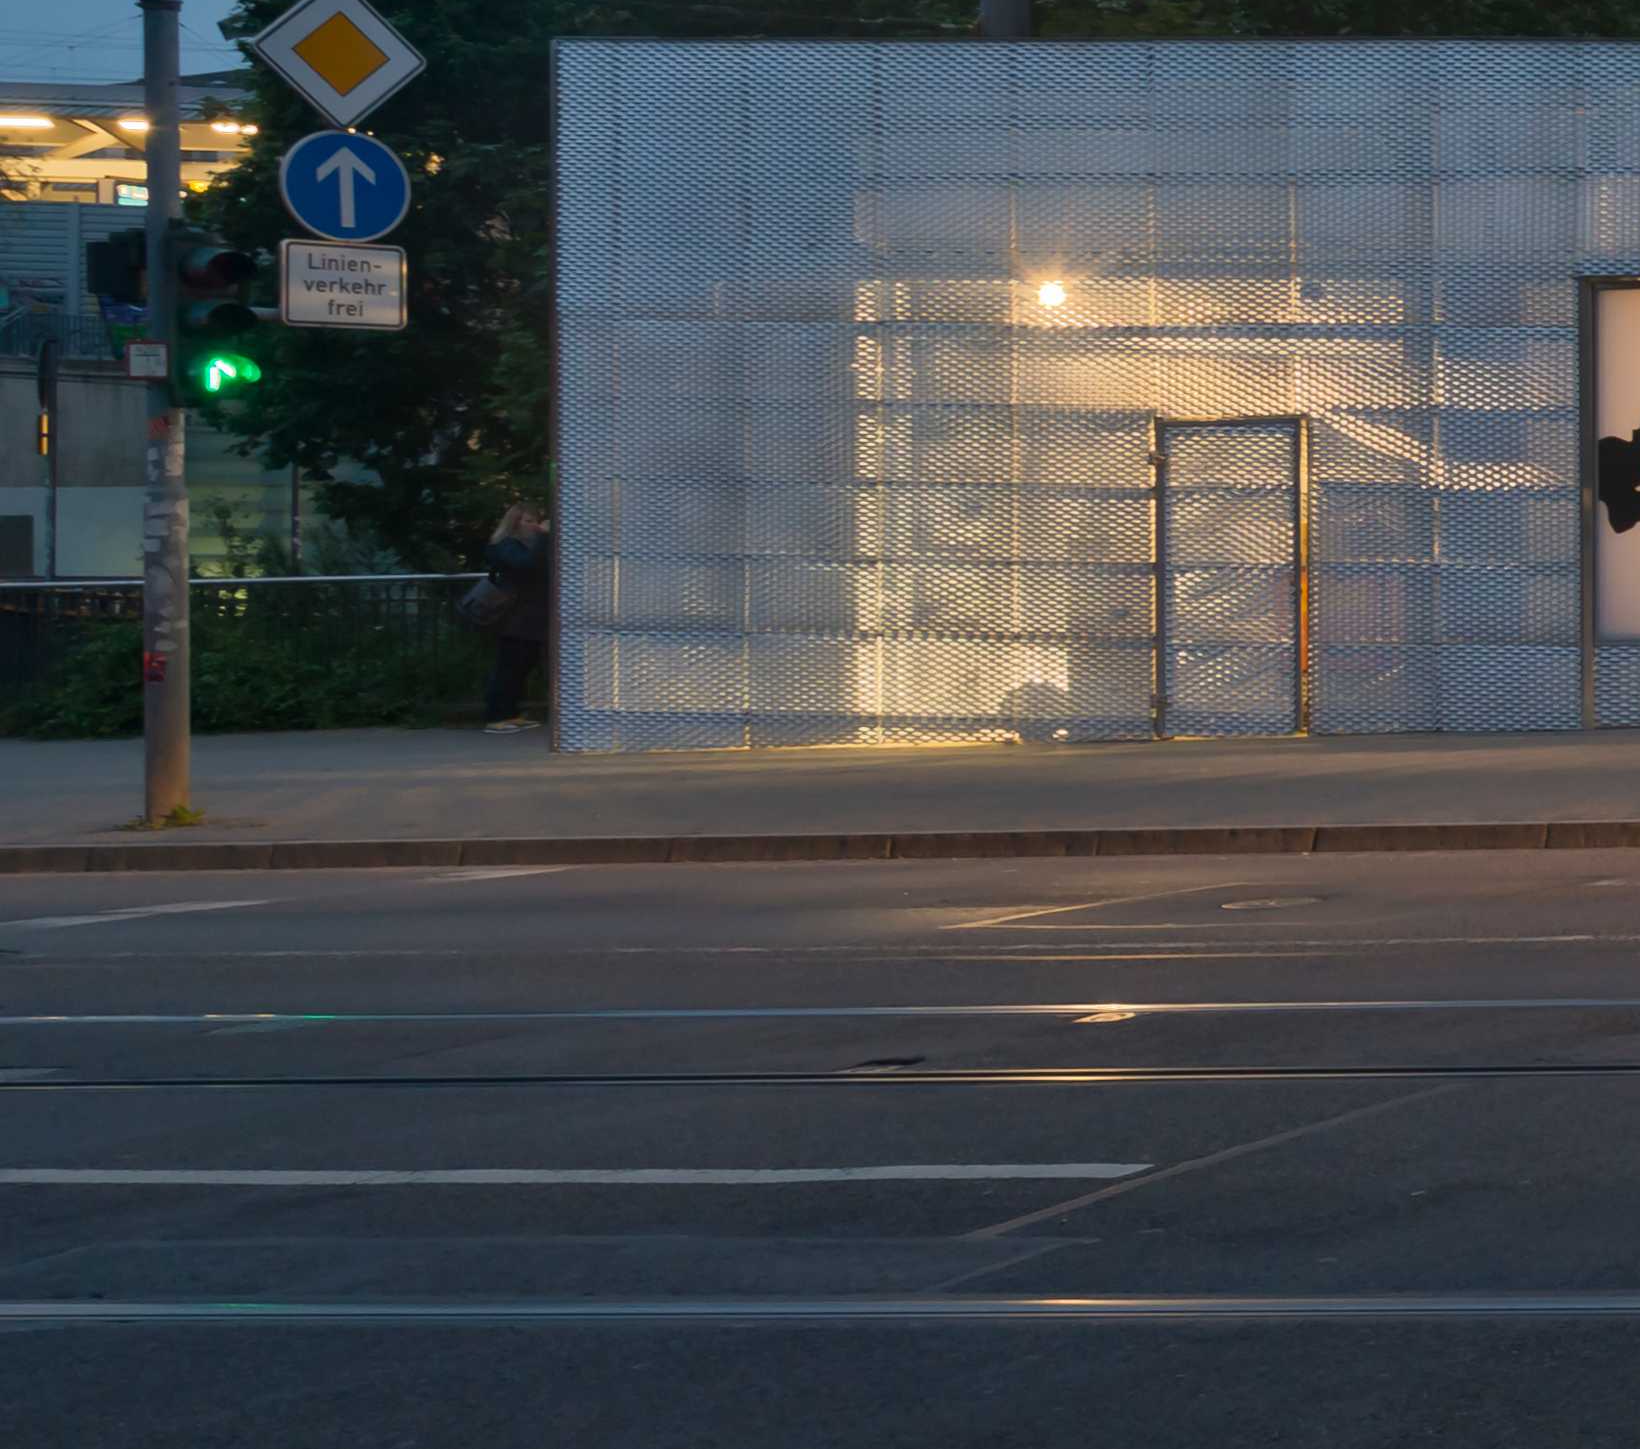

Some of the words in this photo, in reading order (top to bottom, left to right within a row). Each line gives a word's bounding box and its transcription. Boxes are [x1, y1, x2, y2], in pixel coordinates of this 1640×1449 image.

[308, 253, 382, 272] Linien-
[304, 278, 387, 295] verkehr
[328, 300, 363, 317] frei
